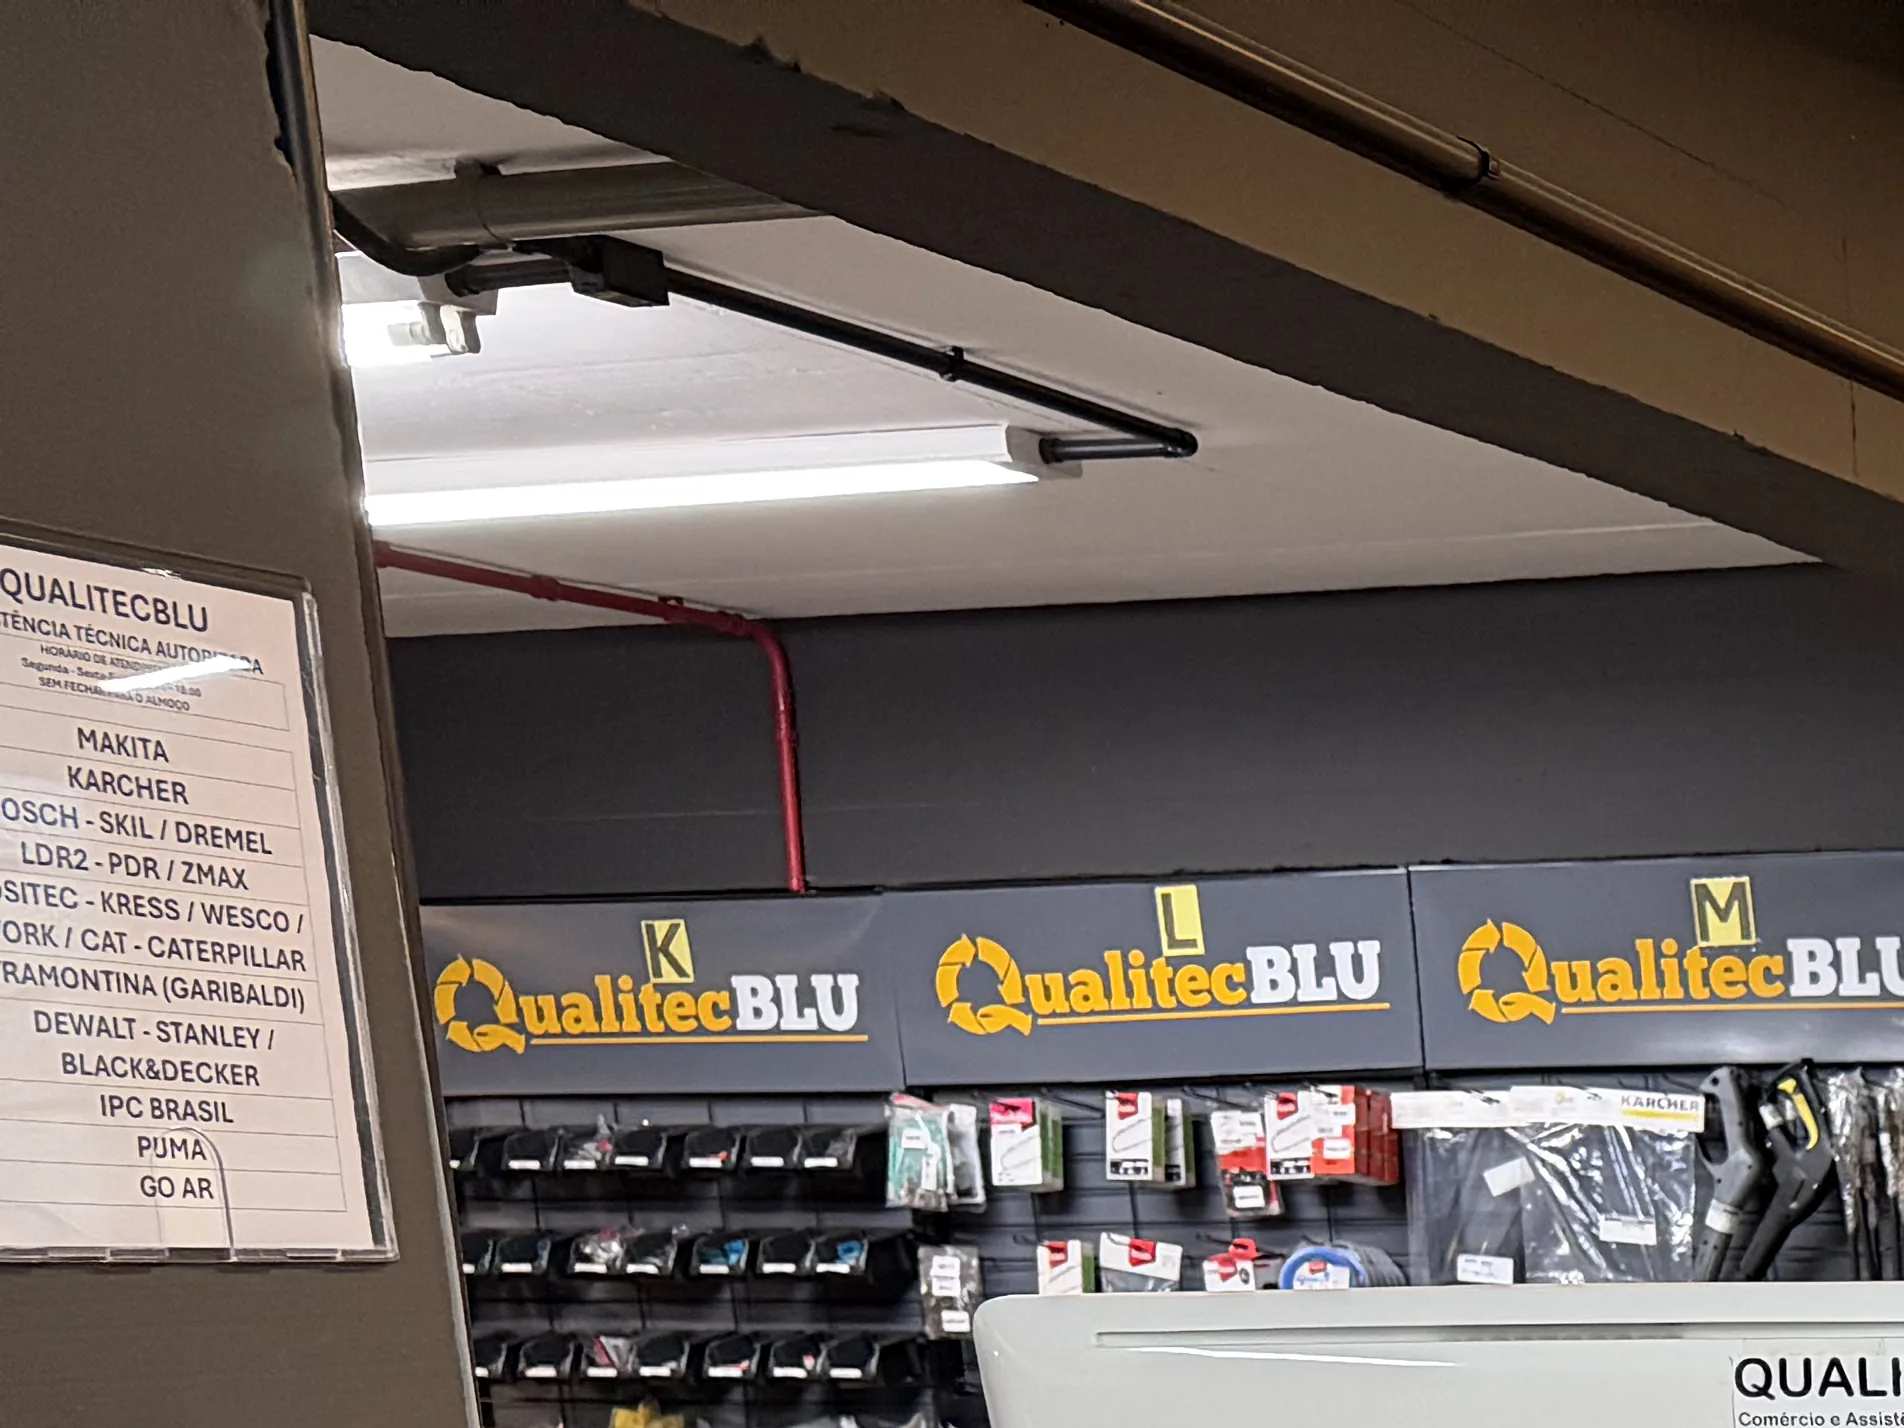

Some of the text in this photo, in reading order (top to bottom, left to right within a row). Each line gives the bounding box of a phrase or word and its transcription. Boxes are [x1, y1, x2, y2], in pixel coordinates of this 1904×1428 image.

[1, 568, 208, 632] QUALITECBLU
[0, 609, 71, 641] TÊNCIA
[74, 624, 152, 655] TÉCNICA
[38, 676, 62, 689] SEM
[77, 727, 170, 763] MAKITA
[67, 765, 189, 805] KARCHER
[99, 811, 153, 840] SKIL
[160, 819, 168, 841] /
[175, 821, 273, 855] DREMEL
[21, 841, 89, 871] LDR2
[108, 852, 160, 880] PDR
[167, 860, 175, 882] /
[181, 861, 249, 890] ZMAX
[0, 879, 78, 909] SITEC
[100, 891, 180, 921] KRESS
[187, 901, 195, 922] /
[201, 902, 290, 933] WESCO
[296, 914, 304, 934] /
[1159, 892, 1199, 950] L
[1693, 881, 1753, 942] M
[0, 919, 59, 948] ORK
[64, 927, 73, 949] /
[81, 929, 127, 954] CAT
[148, 935, 306, 972] CATERPILLAR
[645, 922, 692, 979] K
[0, 960, 305, 1014] RAMONTINA (GARIBALDI)
[434, 953, 859, 1054] QualitecBLU
[935, 932, 1382, 1037] QualitecBLU
[34, 1010, 137, 1040] DEWALT
[157, 1020, 260, 1050] STANLEY
[267, 1029, 275, 1050] /
[61, 1052, 260, 1086] BLACK&DECKER
[100, 1094, 234, 1123] IPC BRASIL
[137, 1136, 208, 1161] PUMA
[140, 1176, 215, 1199] GO AR
[1738, 1411, 1825, 1428] Comércio
[1831, 1415, 1841, 1427] e
